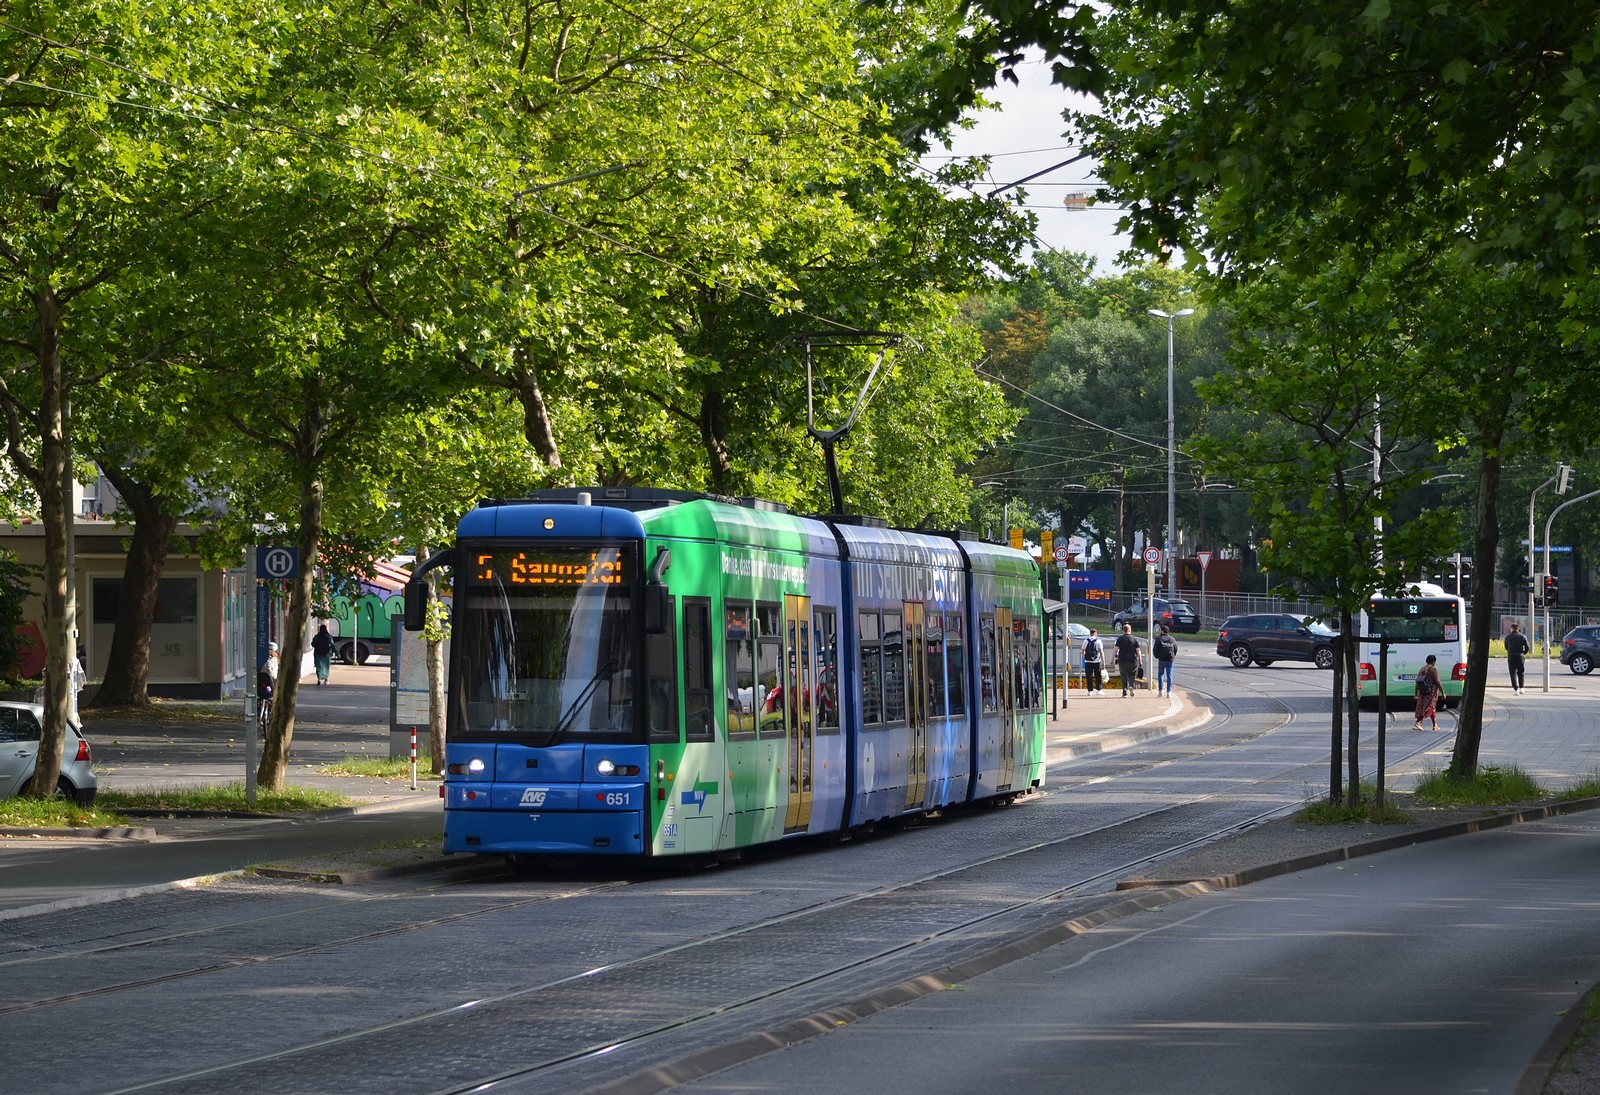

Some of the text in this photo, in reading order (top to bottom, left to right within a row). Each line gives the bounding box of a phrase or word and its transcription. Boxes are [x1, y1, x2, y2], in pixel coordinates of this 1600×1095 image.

[272, 554, 286, 571] H
[1148, 552, 1157, 560] 30
[478, 555, 492, 579] 5
[845, 527, 964, 602] Ihr seid die Besten
[1409, 605, 1418, 614] 52
[259, 632, 267, 648] Platz
[521, 791, 547, 805] KVG
[606, 792, 629, 806] 651
[663, 823, 677, 837] 651A
